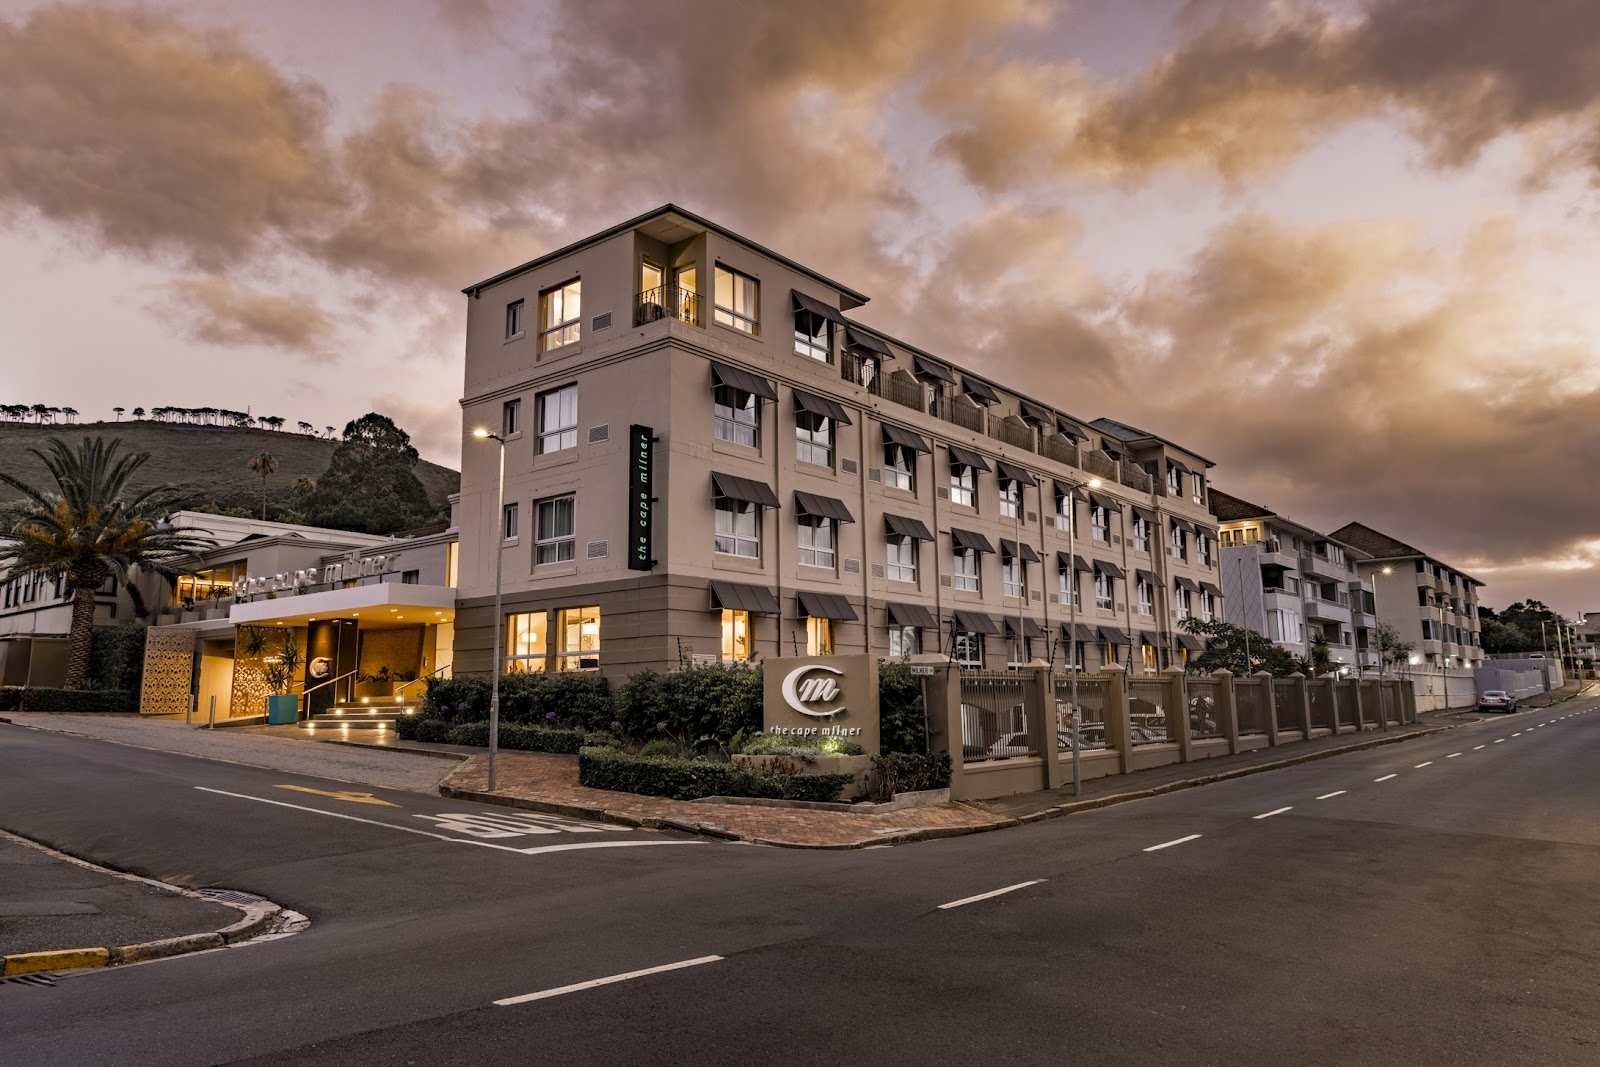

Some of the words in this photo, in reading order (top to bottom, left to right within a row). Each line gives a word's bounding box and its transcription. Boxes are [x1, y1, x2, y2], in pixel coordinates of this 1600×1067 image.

[638, 435, 648, 483] milner
[640, 493, 649, 527] cape
[638, 537, 647, 560] the
[770, 725, 788, 735] the
[790, 727, 818, 737] cape
[821, 724, 862, 737] milner
